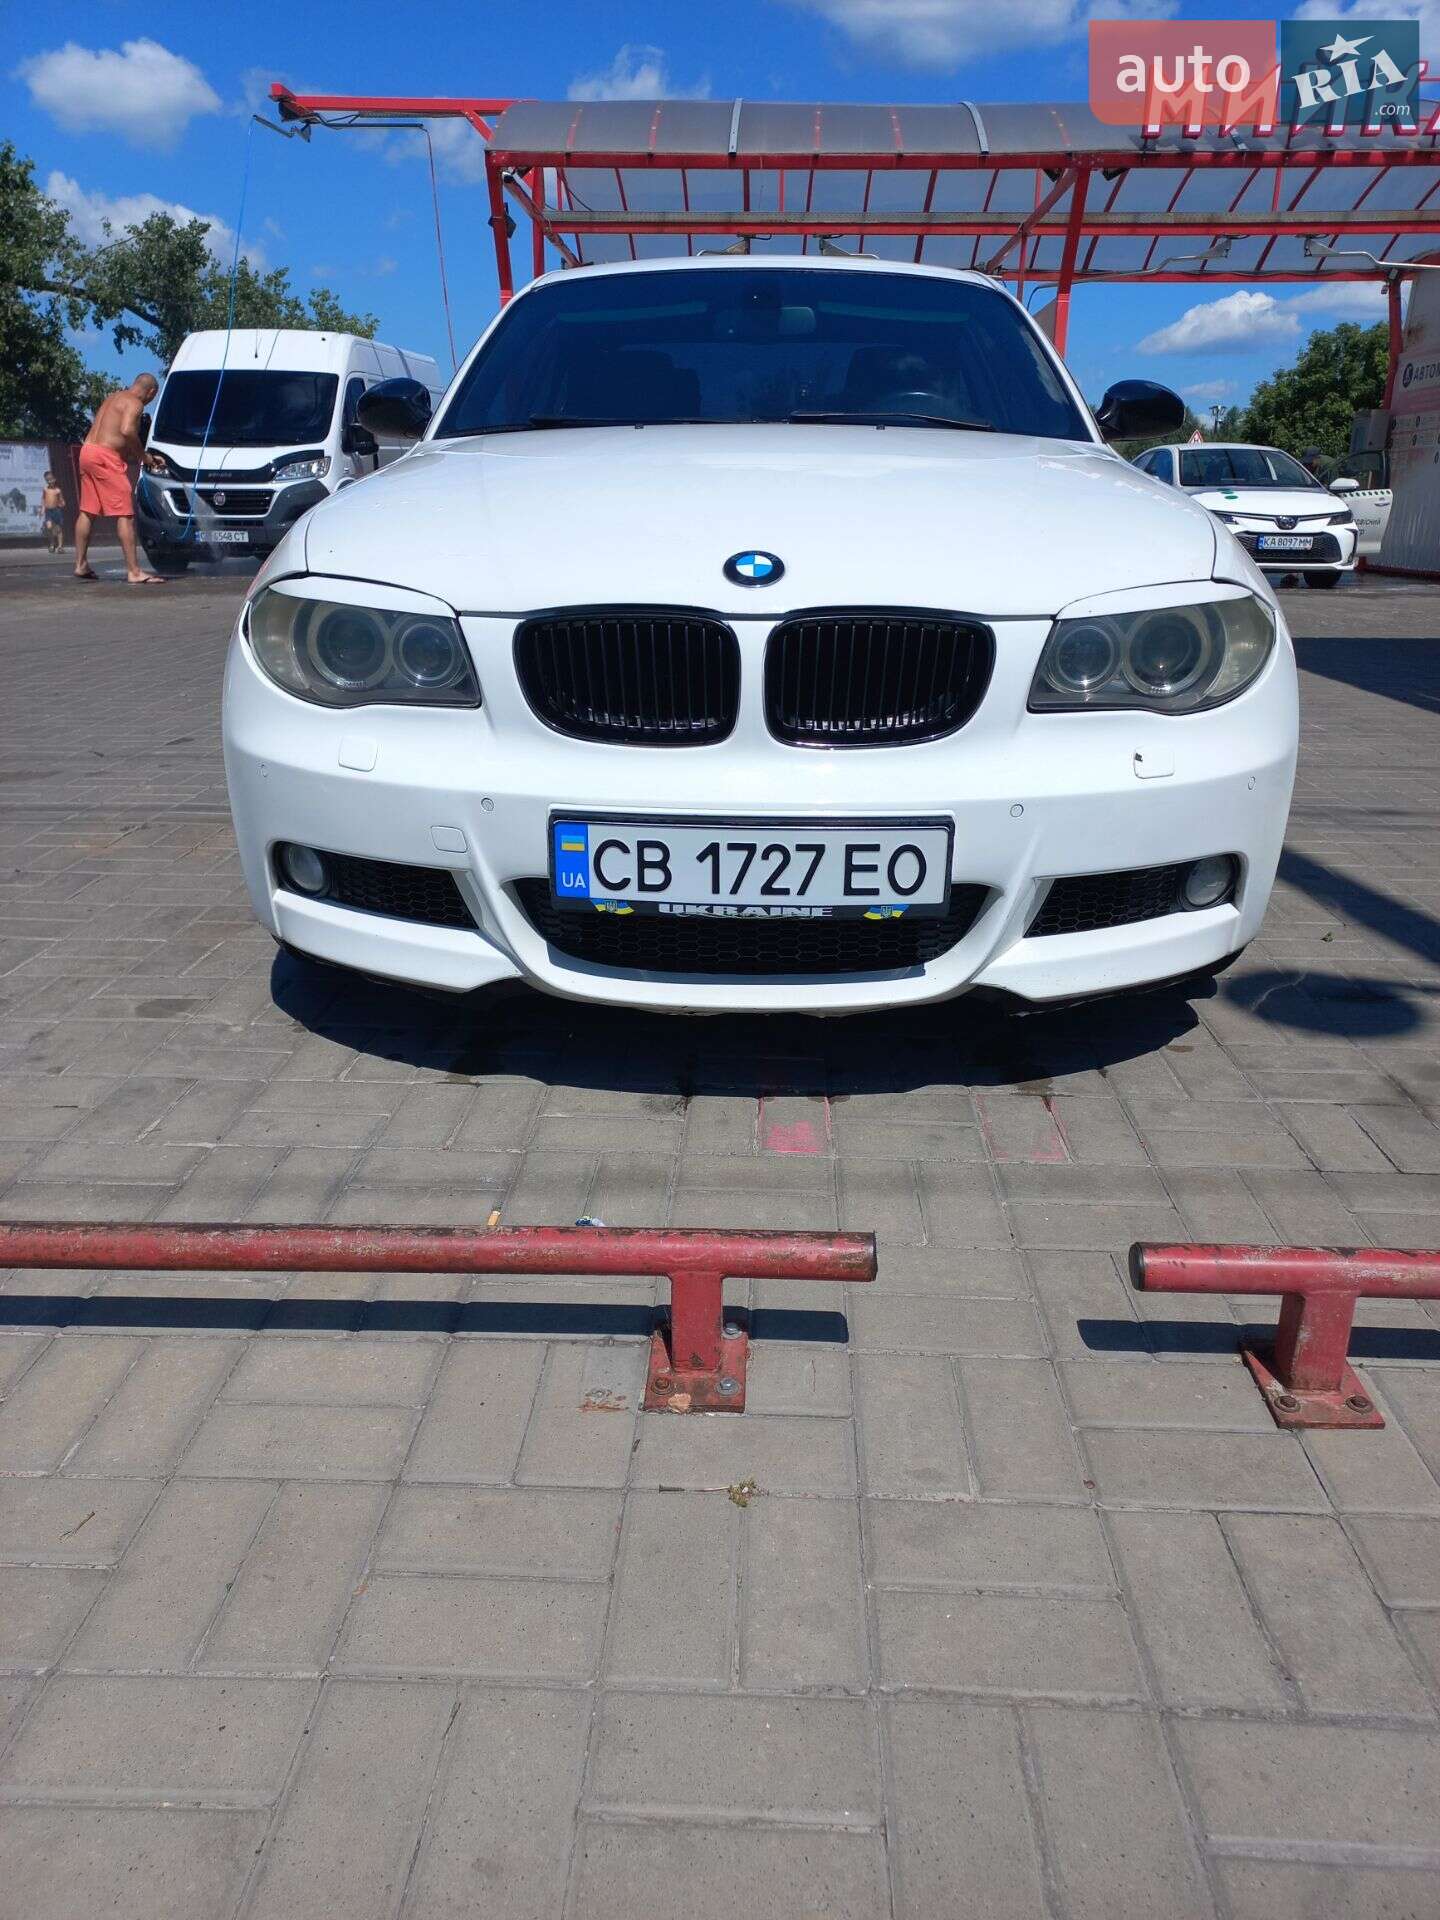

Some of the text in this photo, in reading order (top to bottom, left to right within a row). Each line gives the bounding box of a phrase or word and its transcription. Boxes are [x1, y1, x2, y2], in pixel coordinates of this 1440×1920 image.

[1277, 537, 1298, 547] 8097
[593, 839, 928, 897] CB 1727 EO
[561, 871, 587, 889] UA
[658, 903, 833, 918] UKRAINE
